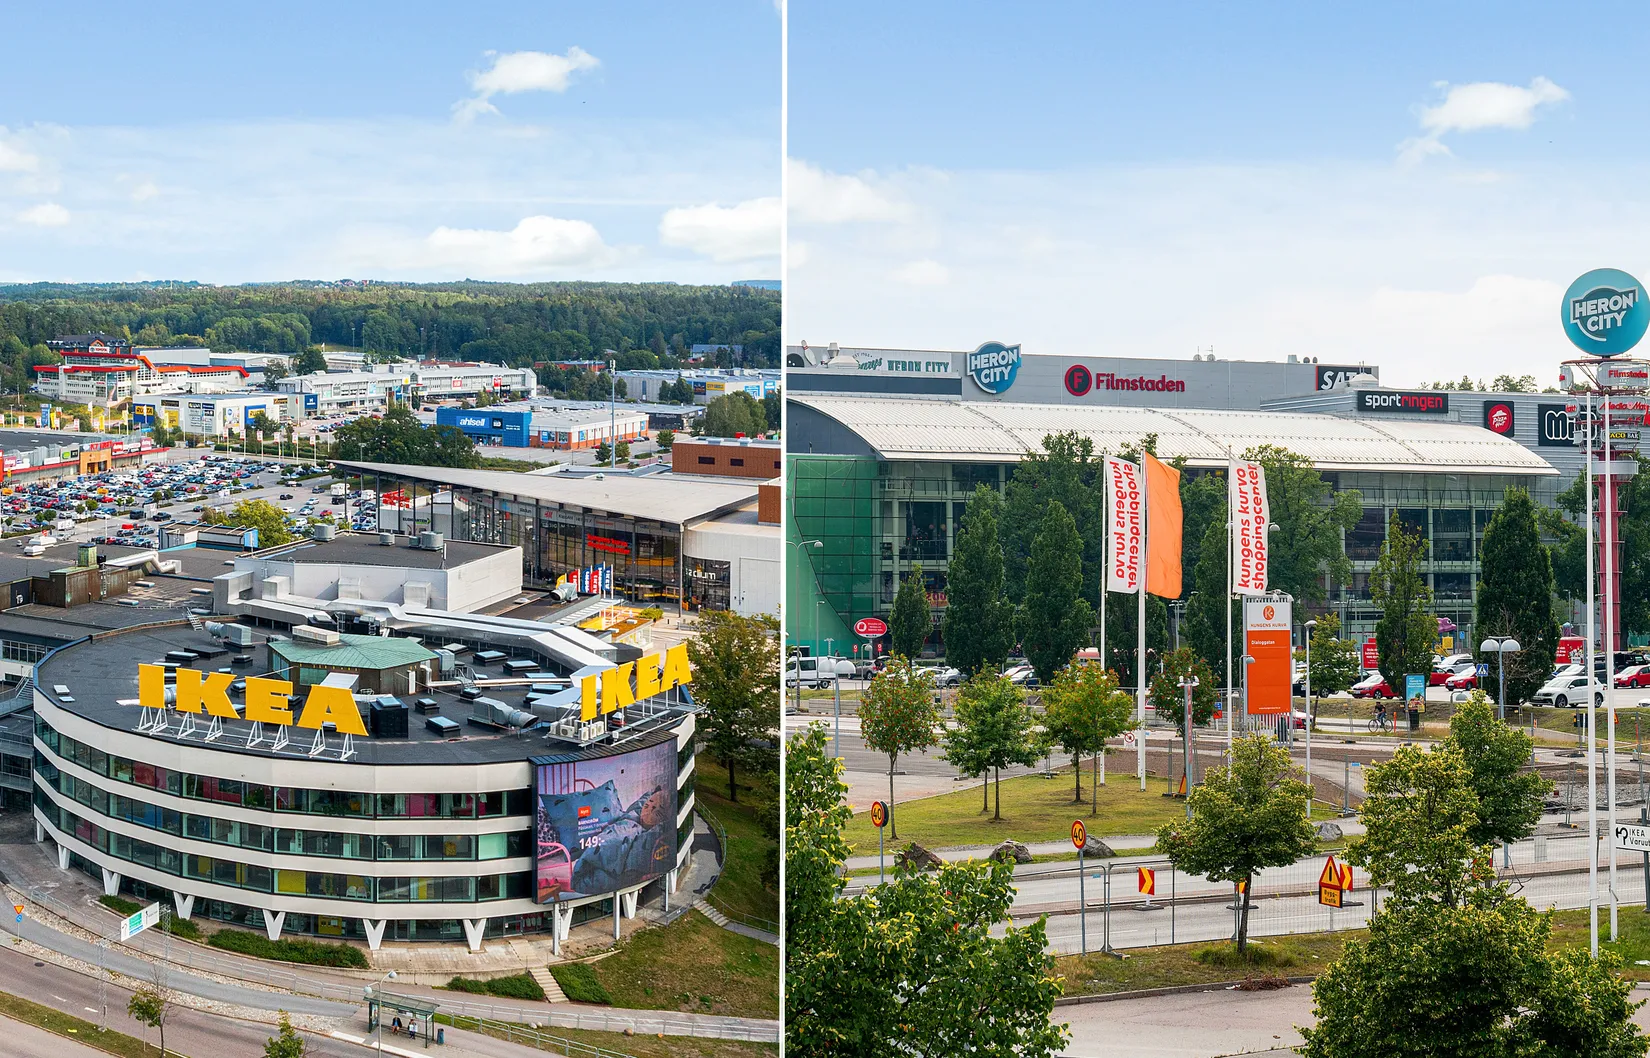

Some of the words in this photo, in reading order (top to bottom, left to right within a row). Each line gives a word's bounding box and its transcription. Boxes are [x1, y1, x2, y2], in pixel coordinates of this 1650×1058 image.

[1574, 292, 1634, 318] HERON
[1586, 310, 1626, 332] CITY
[971, 349, 1018, 370] HERON
[980, 366, 1011, 384] CITY
[1073, 372, 1084, 388] F
[1096, 372, 1186, 392] Filmstaden
[1365, 394, 1443, 411] sportringen
[460, 418, 485, 426] ahlsell
[1238, 518, 1253, 588] kungens
[581, 643, 693, 722] IKEA
[137, 662, 369, 737] IKEA
[874, 808, 881, 820] 40
[1074, 828, 1084, 841] 40
[1630, 828, 1645, 837] IKEA
